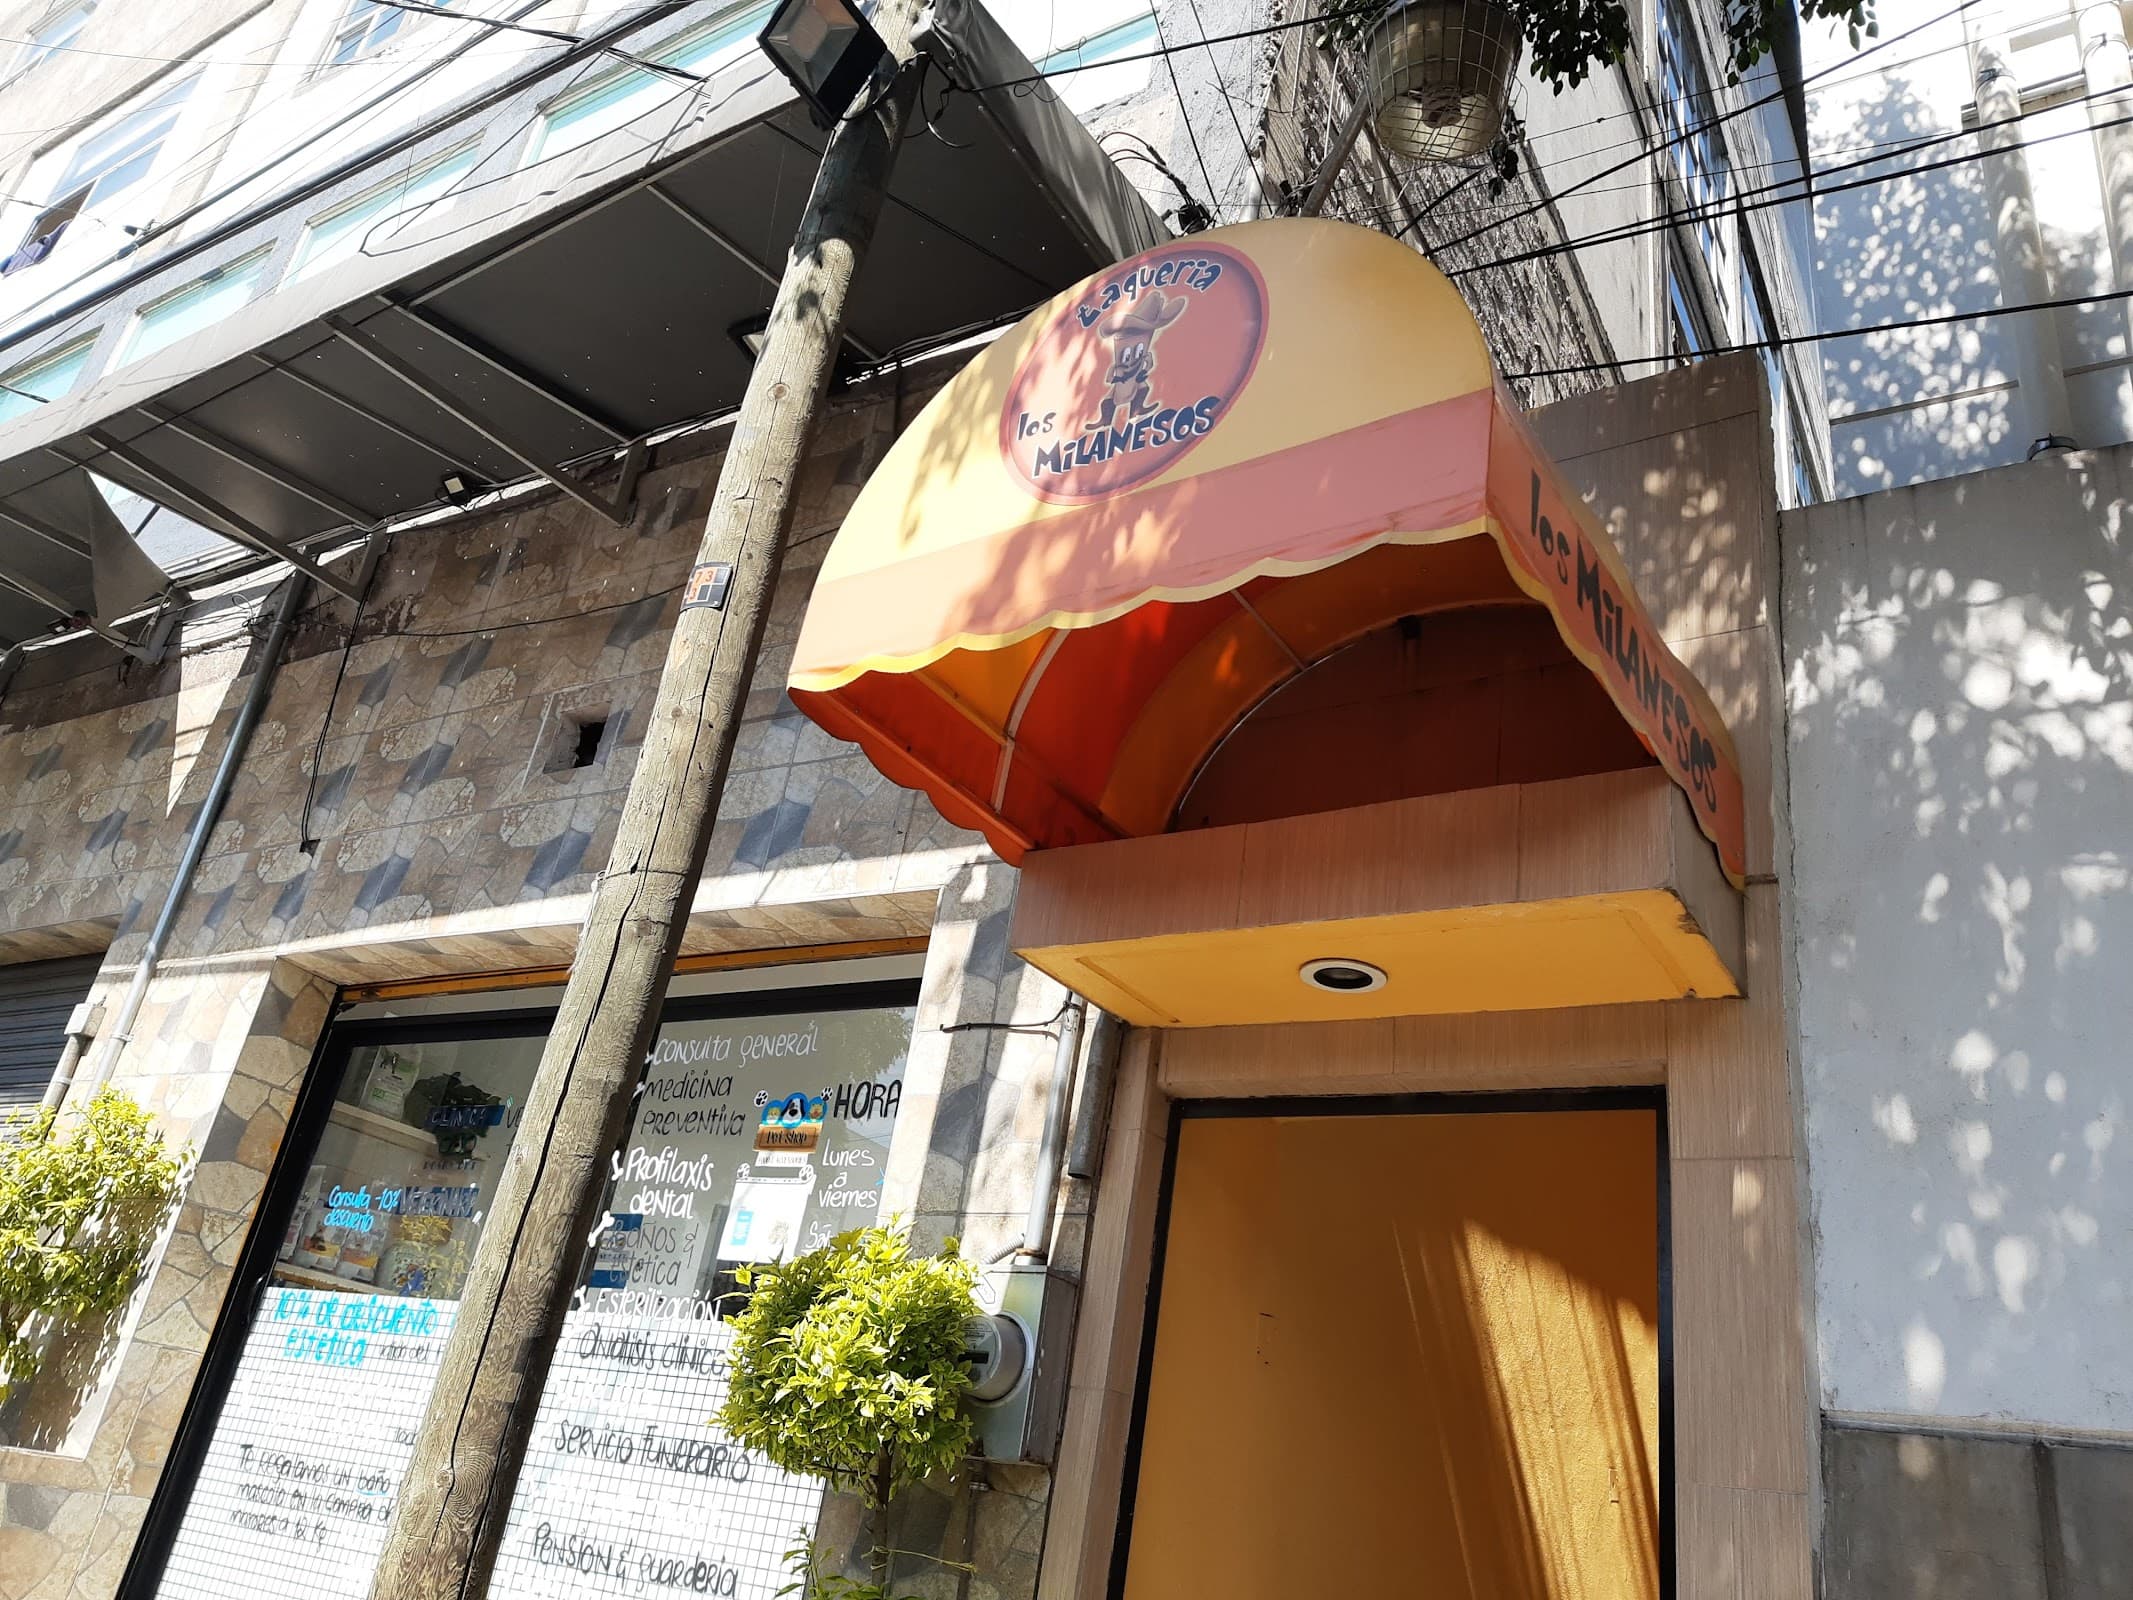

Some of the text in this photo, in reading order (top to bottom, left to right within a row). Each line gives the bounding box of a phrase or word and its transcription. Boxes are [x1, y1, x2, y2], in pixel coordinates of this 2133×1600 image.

[1077, 259, 1222, 329] taqueria
[1017, 411, 1056, 440] los
[1531, 468, 1569, 585] los
[643, 1069, 733, 1102] medicina
[624, 1146, 714, 1191] Profilaxis
[818, 1184, 878, 1209] viernes
